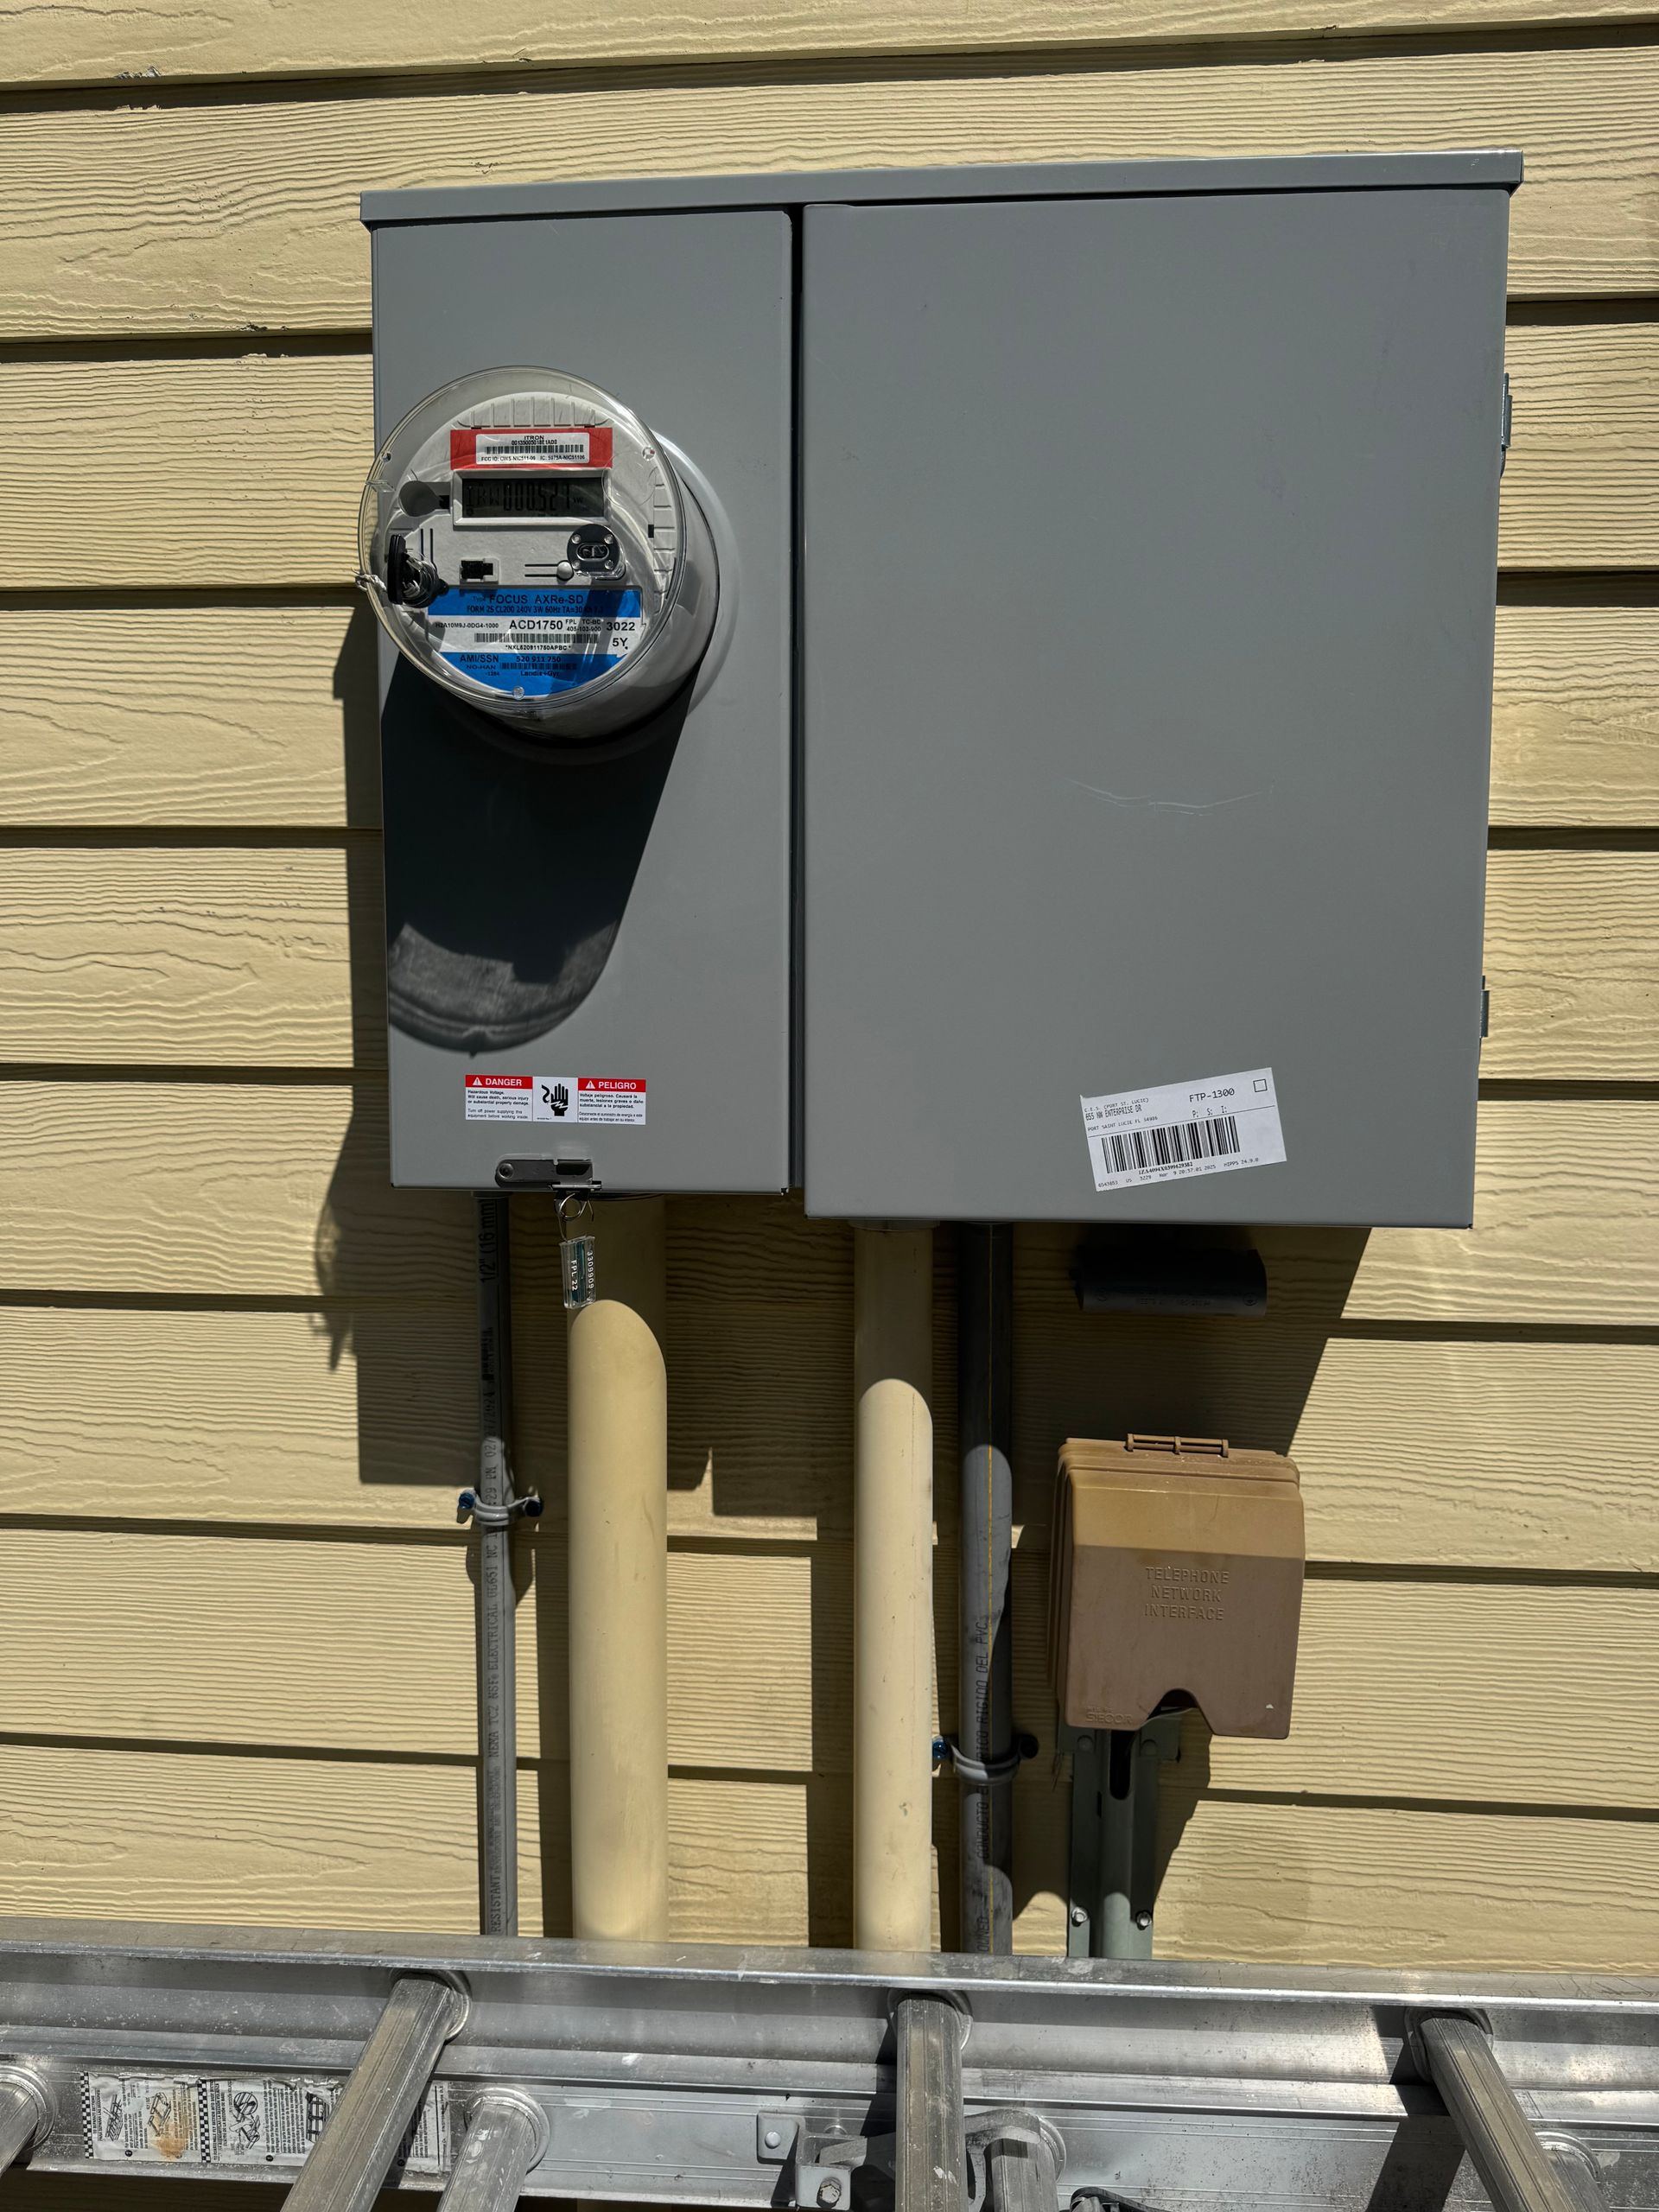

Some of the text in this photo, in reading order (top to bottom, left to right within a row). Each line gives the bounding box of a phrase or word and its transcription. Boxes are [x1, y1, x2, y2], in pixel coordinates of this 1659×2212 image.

[489, 594, 528, 604] FOCUS
[534, 594, 584, 604] AXRe-SD
[510, 620, 563, 630] ACD1750
[607, 621, 636, 632] 3022
[1189, 1087, 1235, 1102] FTP-1300
[1104, 1105, 1133, 1117] ENTERPRISE
[1135, 1103, 1141, 1112] DR
[1192, 1109, 1198, 1118] P:
[1206, 1107, 1212, 1116] S:
[572, 1280, 578, 1292] 22
[1145, 1566, 1230, 1584] TELEPHONE
[1151, 1585, 1222, 1602] NETWORK
[1144, 1604, 1224, 1621] INTERFACE
[486, 1604, 499, 1671] ELECTRICAL
[975, 1621, 988, 1644] PVC
[976, 1654, 988, 1674] DEL
[975, 1680, 988, 1724] RIGIDO
[487, 1706, 499, 1725] TC2
[487, 1731, 499, 1758] NEMA
[490, 1875, 502, 1933] RESISTANT
